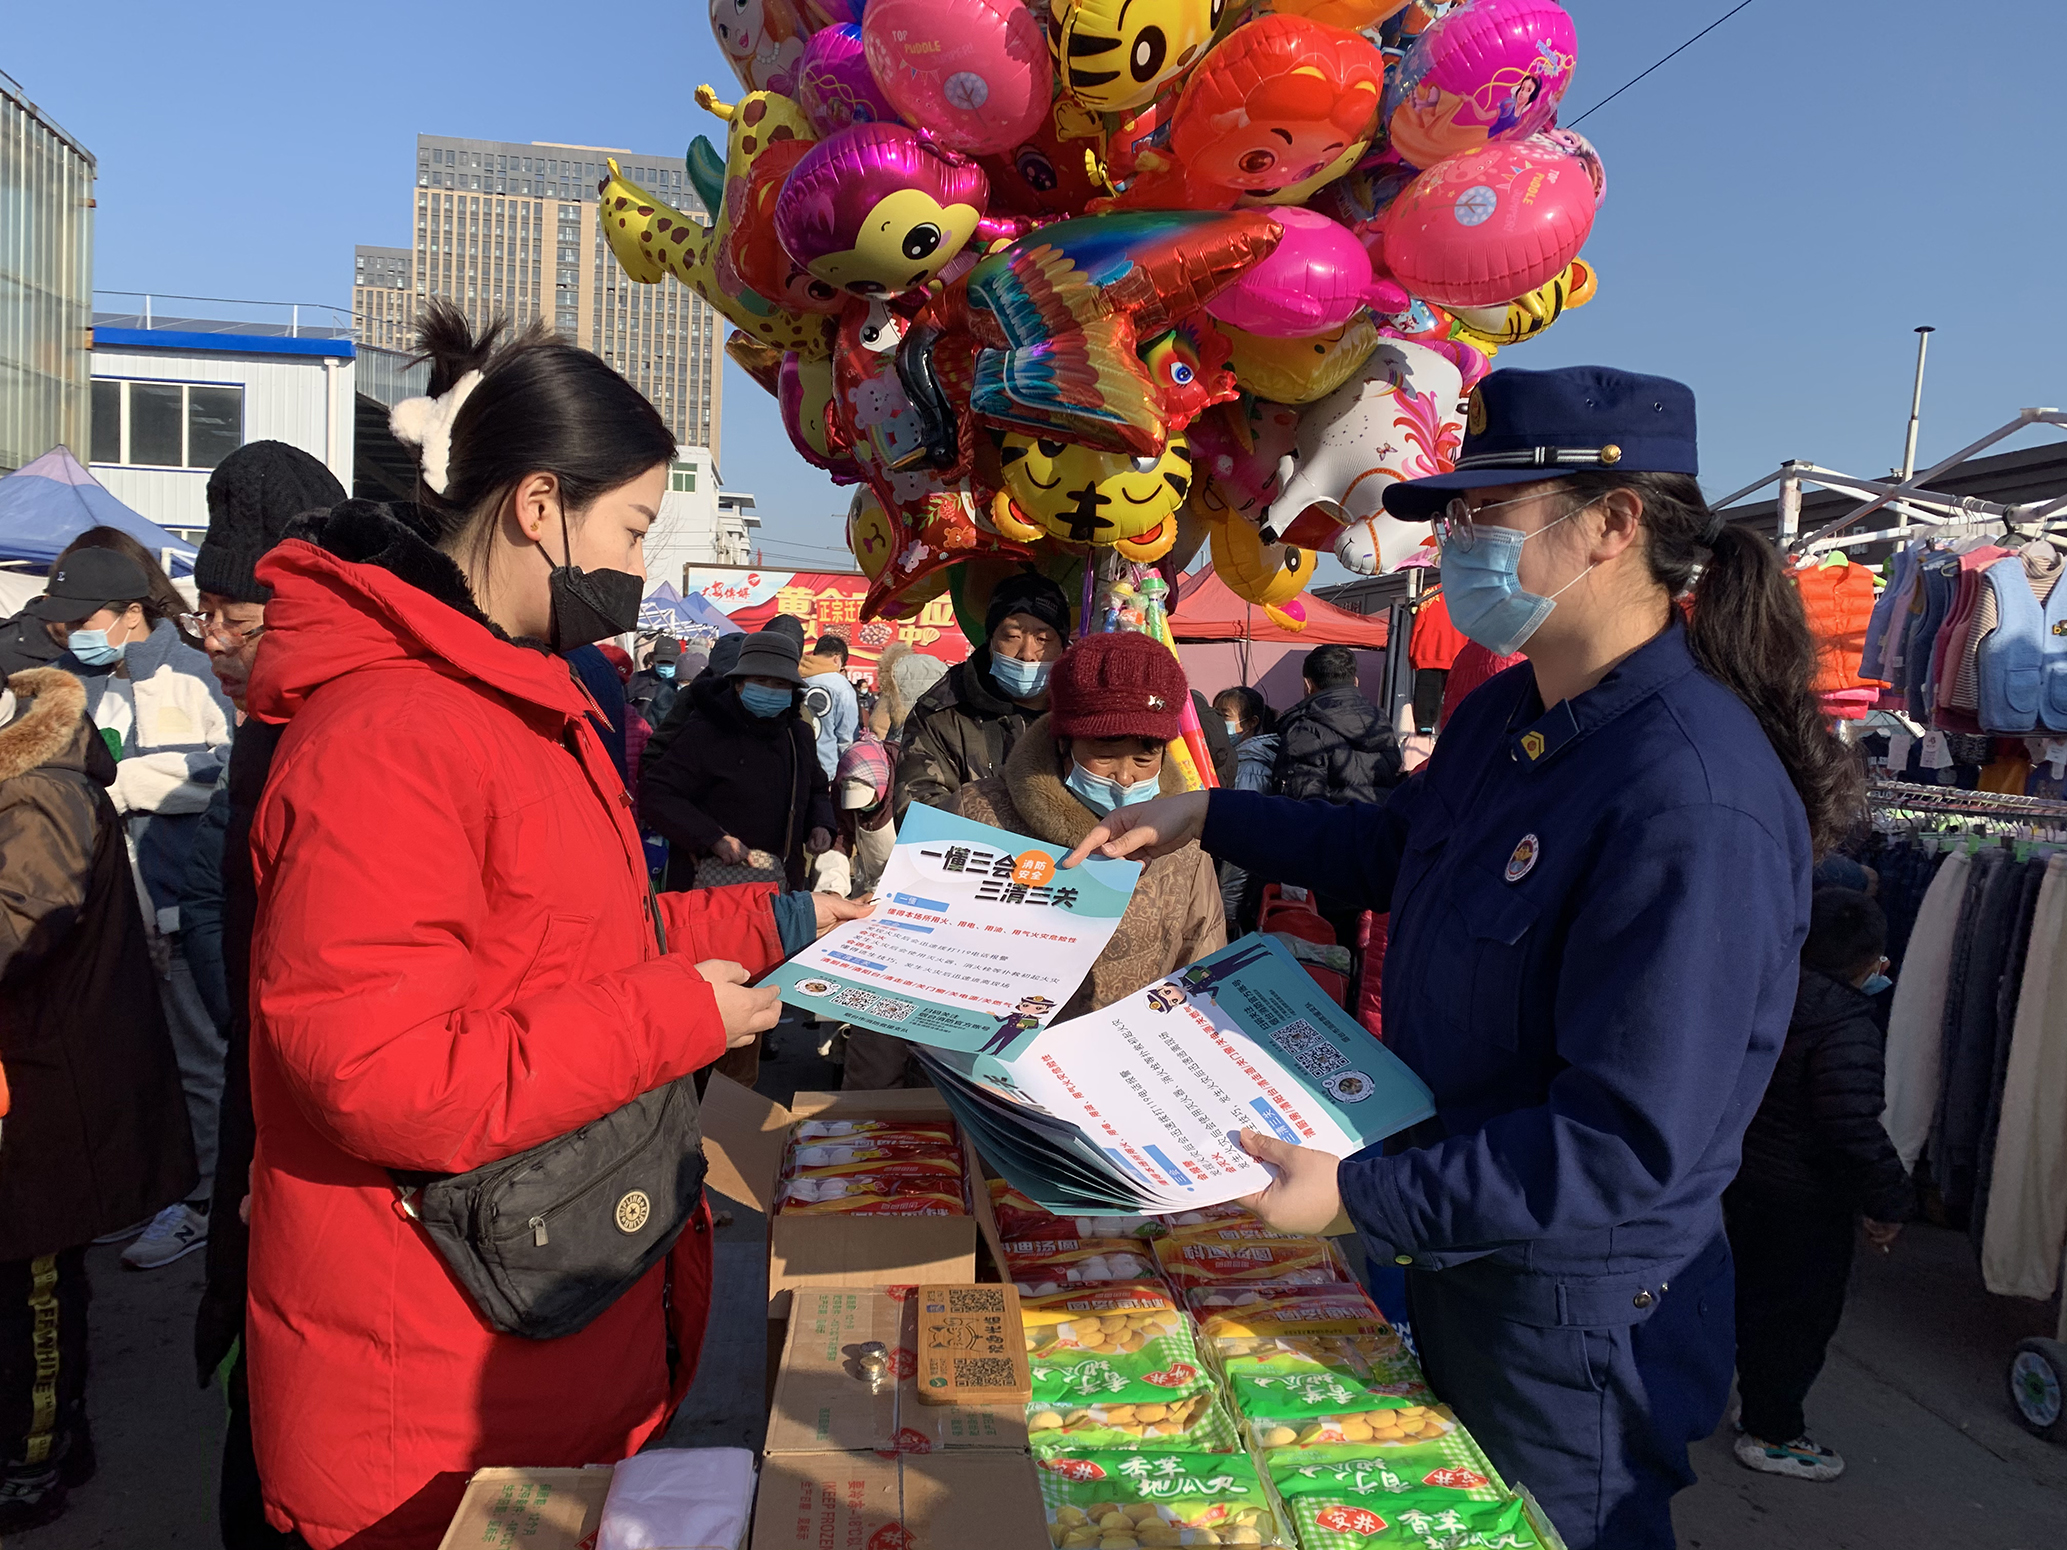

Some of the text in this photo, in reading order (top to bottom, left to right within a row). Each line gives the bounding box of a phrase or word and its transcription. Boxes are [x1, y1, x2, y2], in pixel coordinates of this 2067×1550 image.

[892, 30, 908, 42] TOP
[904, 40, 941, 54] PUDDLE
[1522, 172, 1545, 206] PUDDLE
[1547, 169, 1560, 184] TOP
[919, 845, 1048, 880] 一懂三会 消防
[974, 869, 1080, 908] 安全 三清三关
[1118, 1068, 1223, 1177] 发现火灾后会迅速拨打119电话报警
[1259, 1107, 1297, 1143] 三清三关
[1166, 1167, 1189, 1185] 三会
[1209, 1150, 1236, 1174] 会灭火
